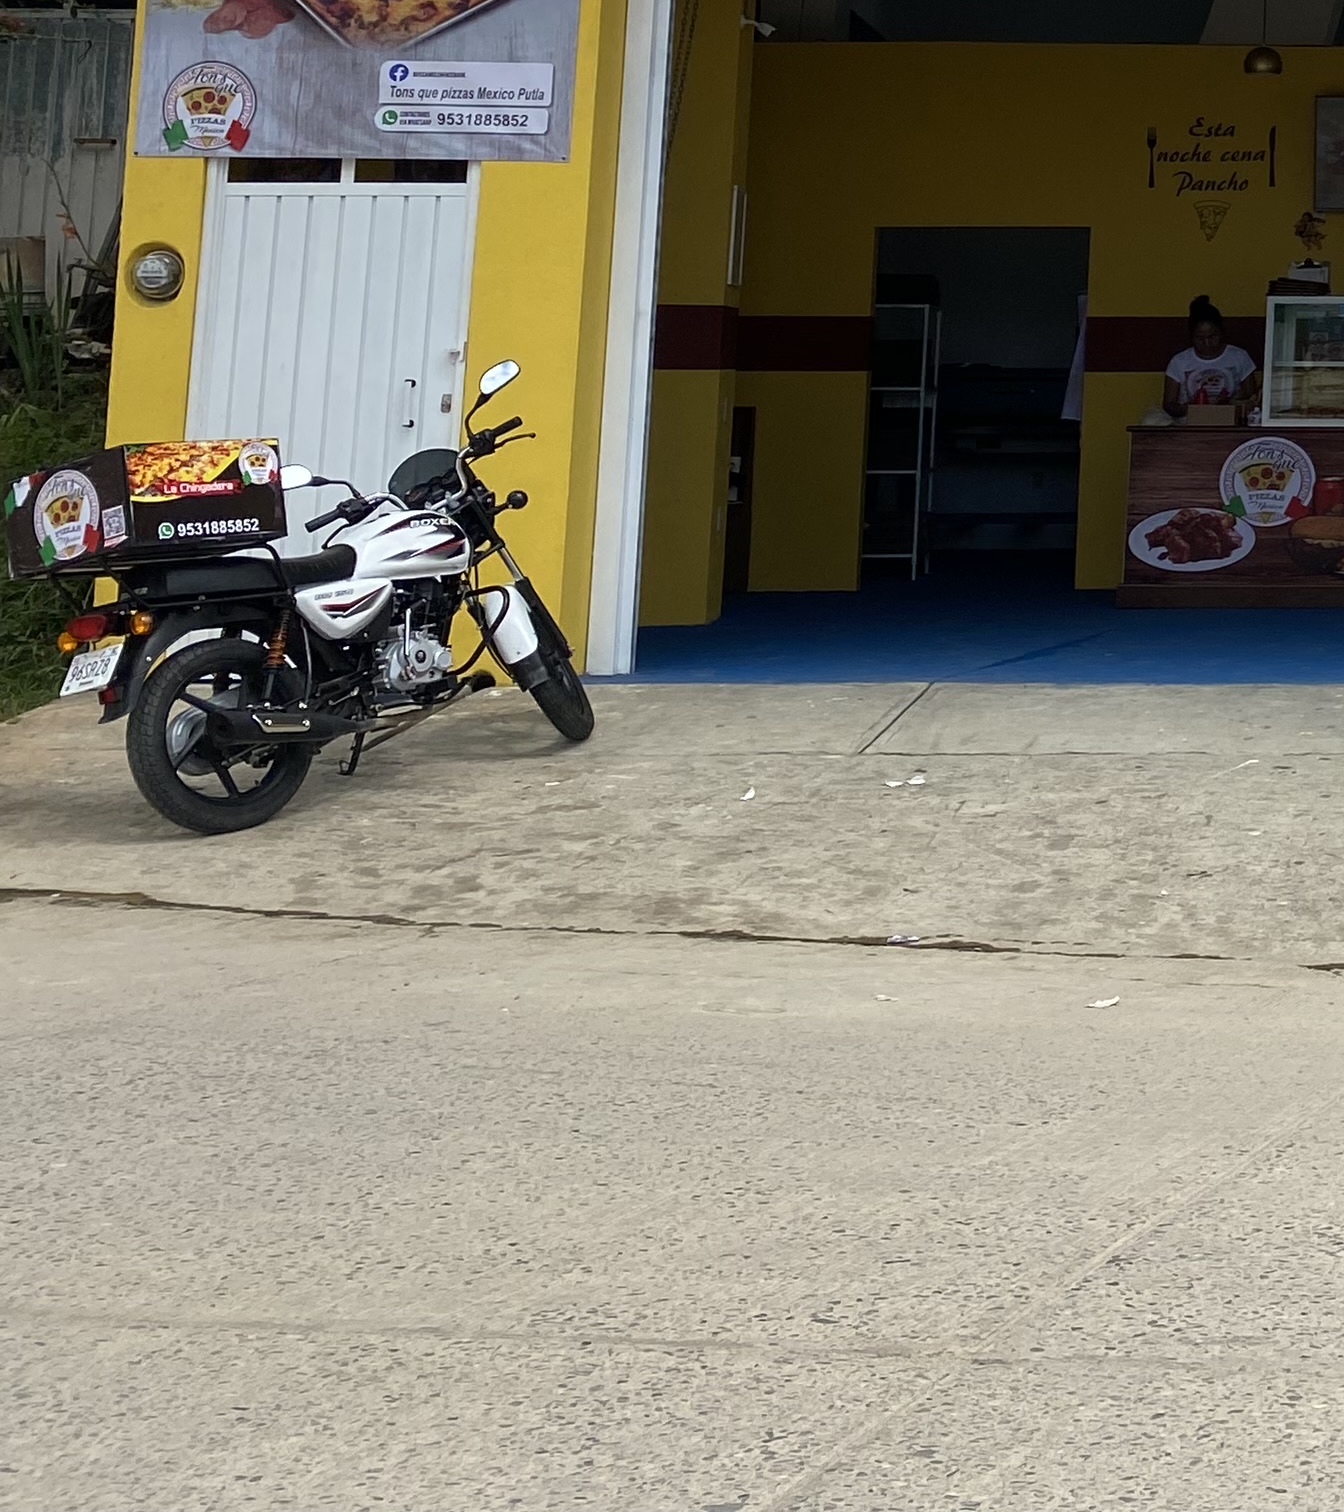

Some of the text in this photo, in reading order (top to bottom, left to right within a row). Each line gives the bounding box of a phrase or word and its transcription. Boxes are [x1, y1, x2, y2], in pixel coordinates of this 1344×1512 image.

[390, 85, 545, 101] Tons que pizzas Mexico Putla
[191, 117, 226, 126] PIZZAS
[437, 113, 529, 127] 9531885852
[1188, 117, 1236, 137] Esta
[1157, 143, 1266, 162] noche cena
[1172, 171, 1249, 197] Pancho
[164, 482, 234, 494] La Chingadera
[1248, 493, 1285, 501] PIZZAS
[177, 519, 260, 536] 9531885852
